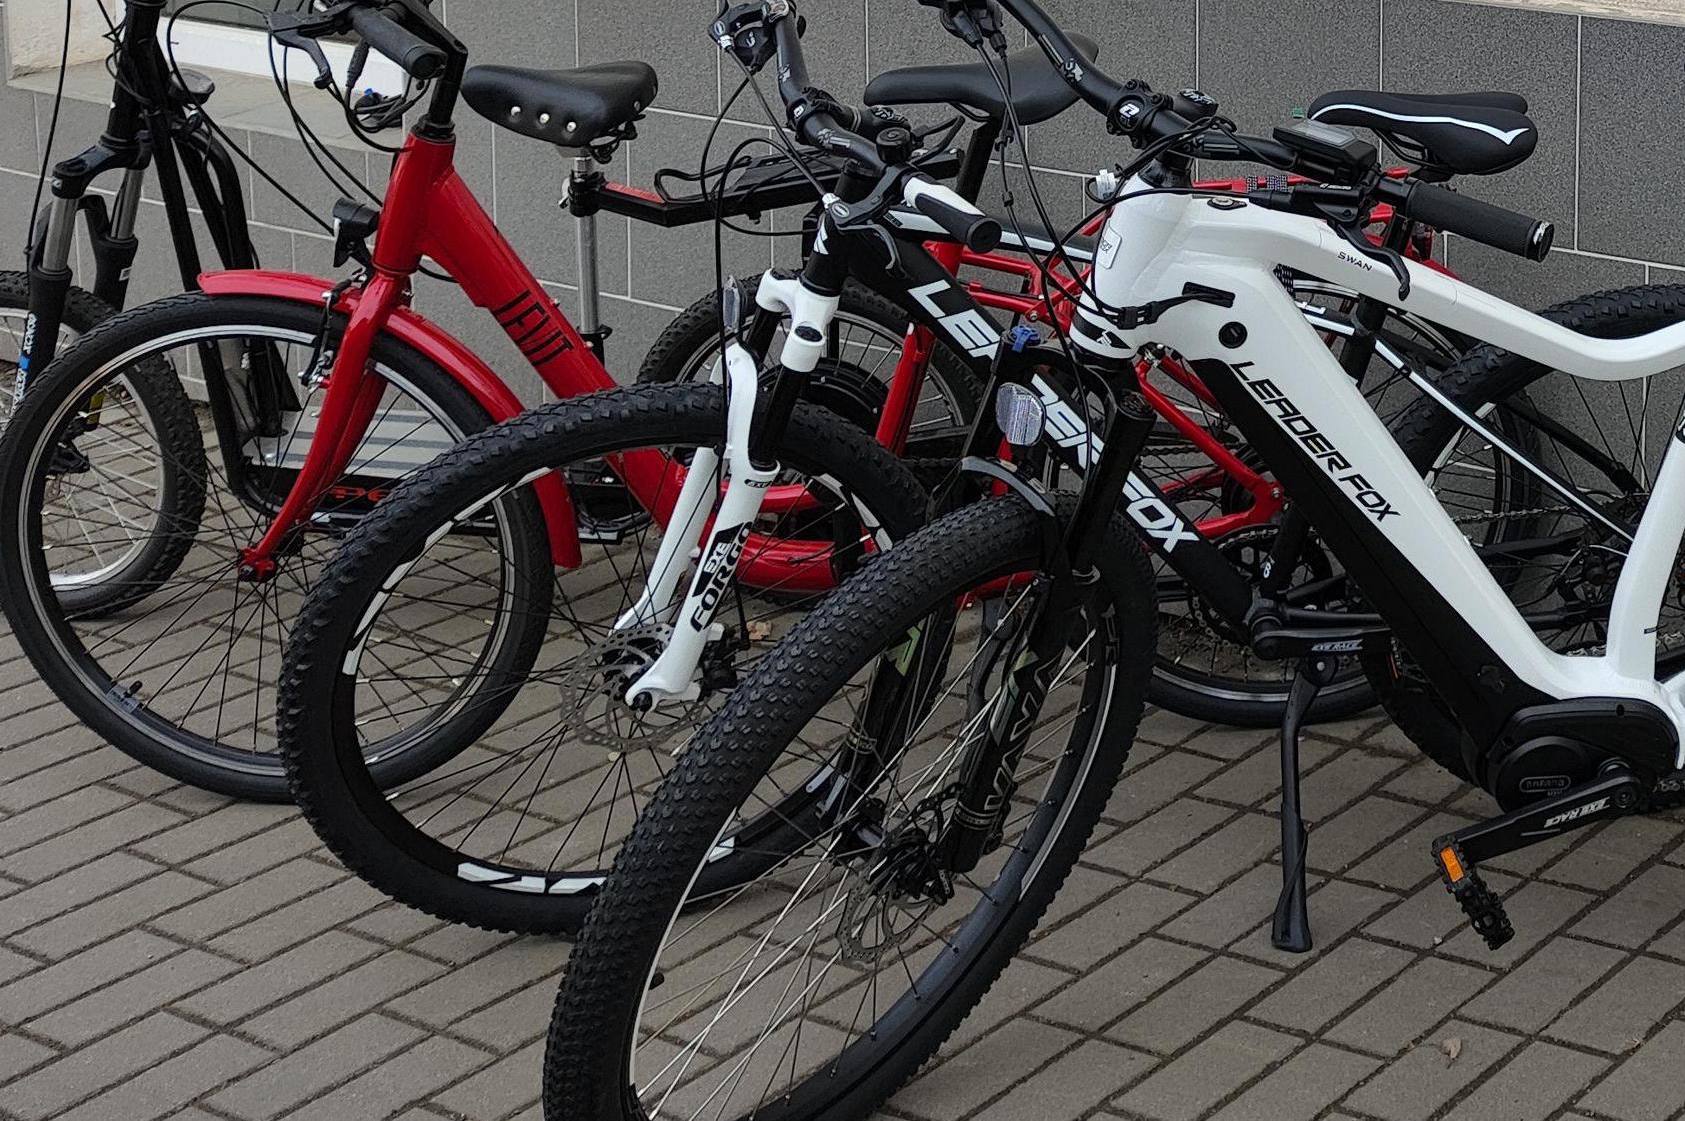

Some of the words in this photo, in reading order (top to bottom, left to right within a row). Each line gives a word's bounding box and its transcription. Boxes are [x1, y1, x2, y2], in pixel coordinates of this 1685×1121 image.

[1336, 251, 1373, 272] SWAN
[1229, 360, 1353, 474] LEADER
[1337, 473, 1401, 522] FOX
